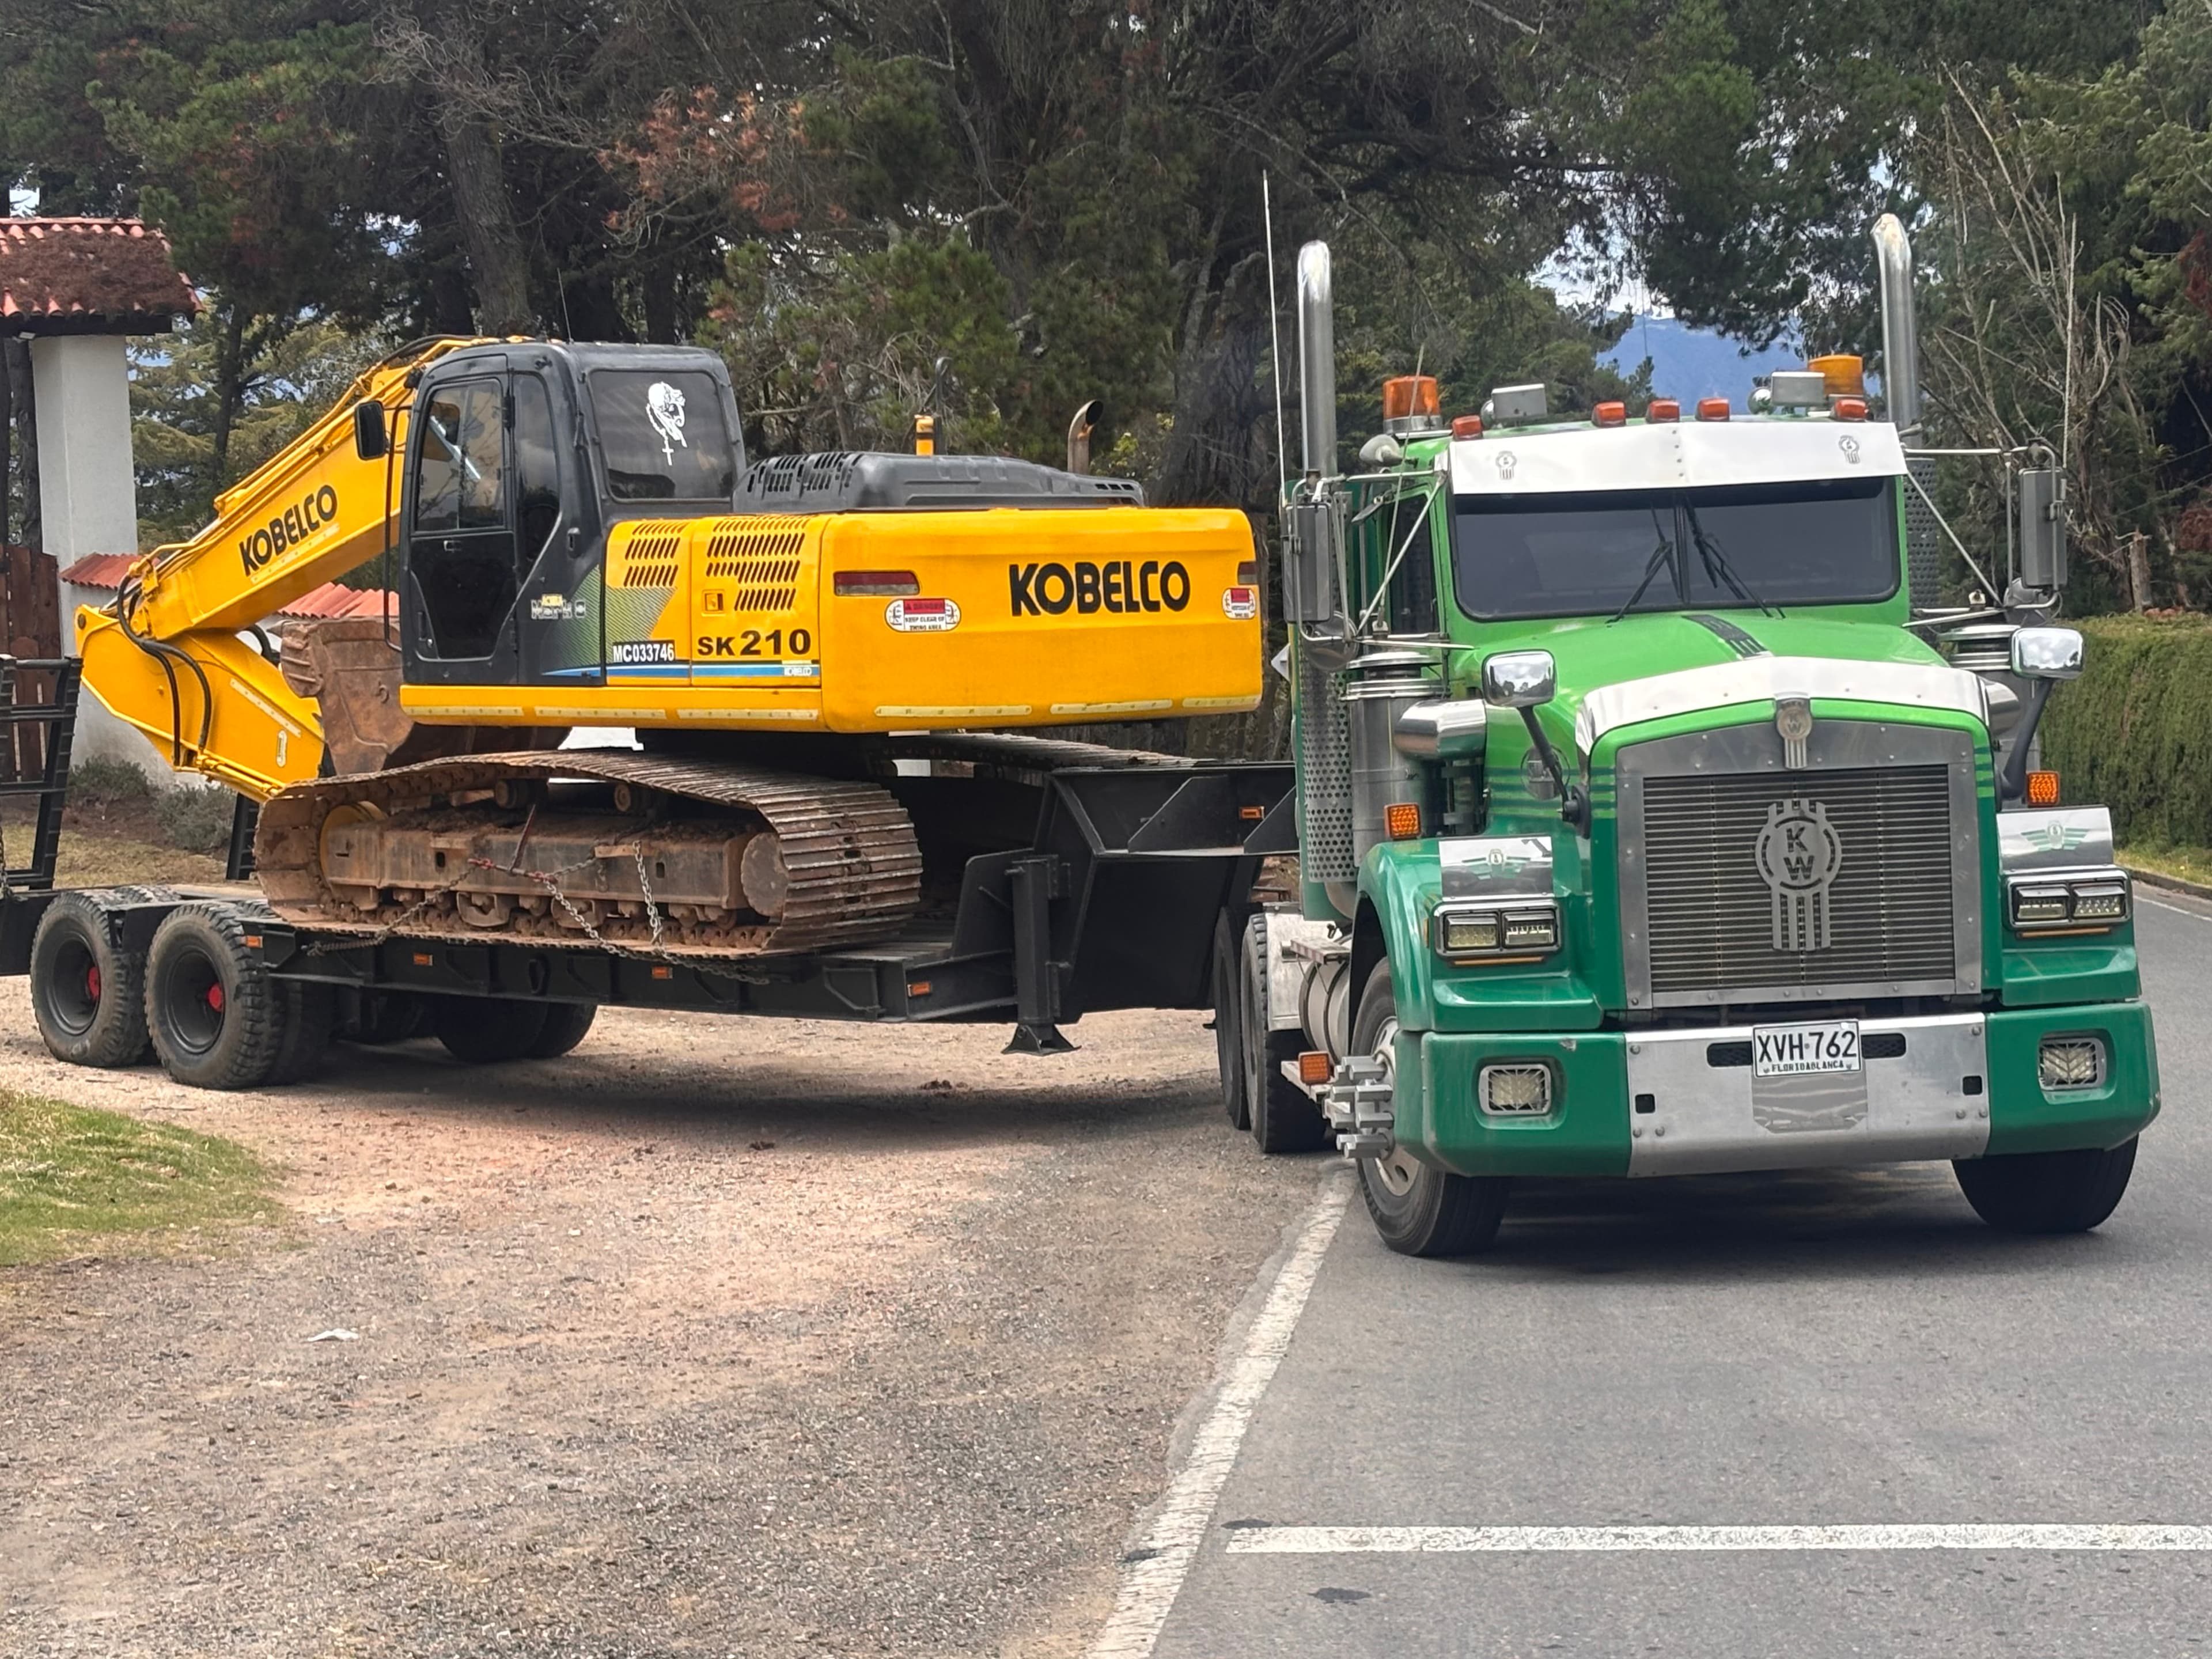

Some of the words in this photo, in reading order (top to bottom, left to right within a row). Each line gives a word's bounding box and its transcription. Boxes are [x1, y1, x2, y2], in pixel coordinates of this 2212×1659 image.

[239, 485, 338, 576] KOBELCO
[1009, 560, 1191, 617] KOBELCO
[613, 643, 675, 662] MC033746
[1786, 826, 1808, 853] K
[1783, 855, 1814, 880] W
[1772, 1060, 1844, 1073] FLORIDABLANCA
